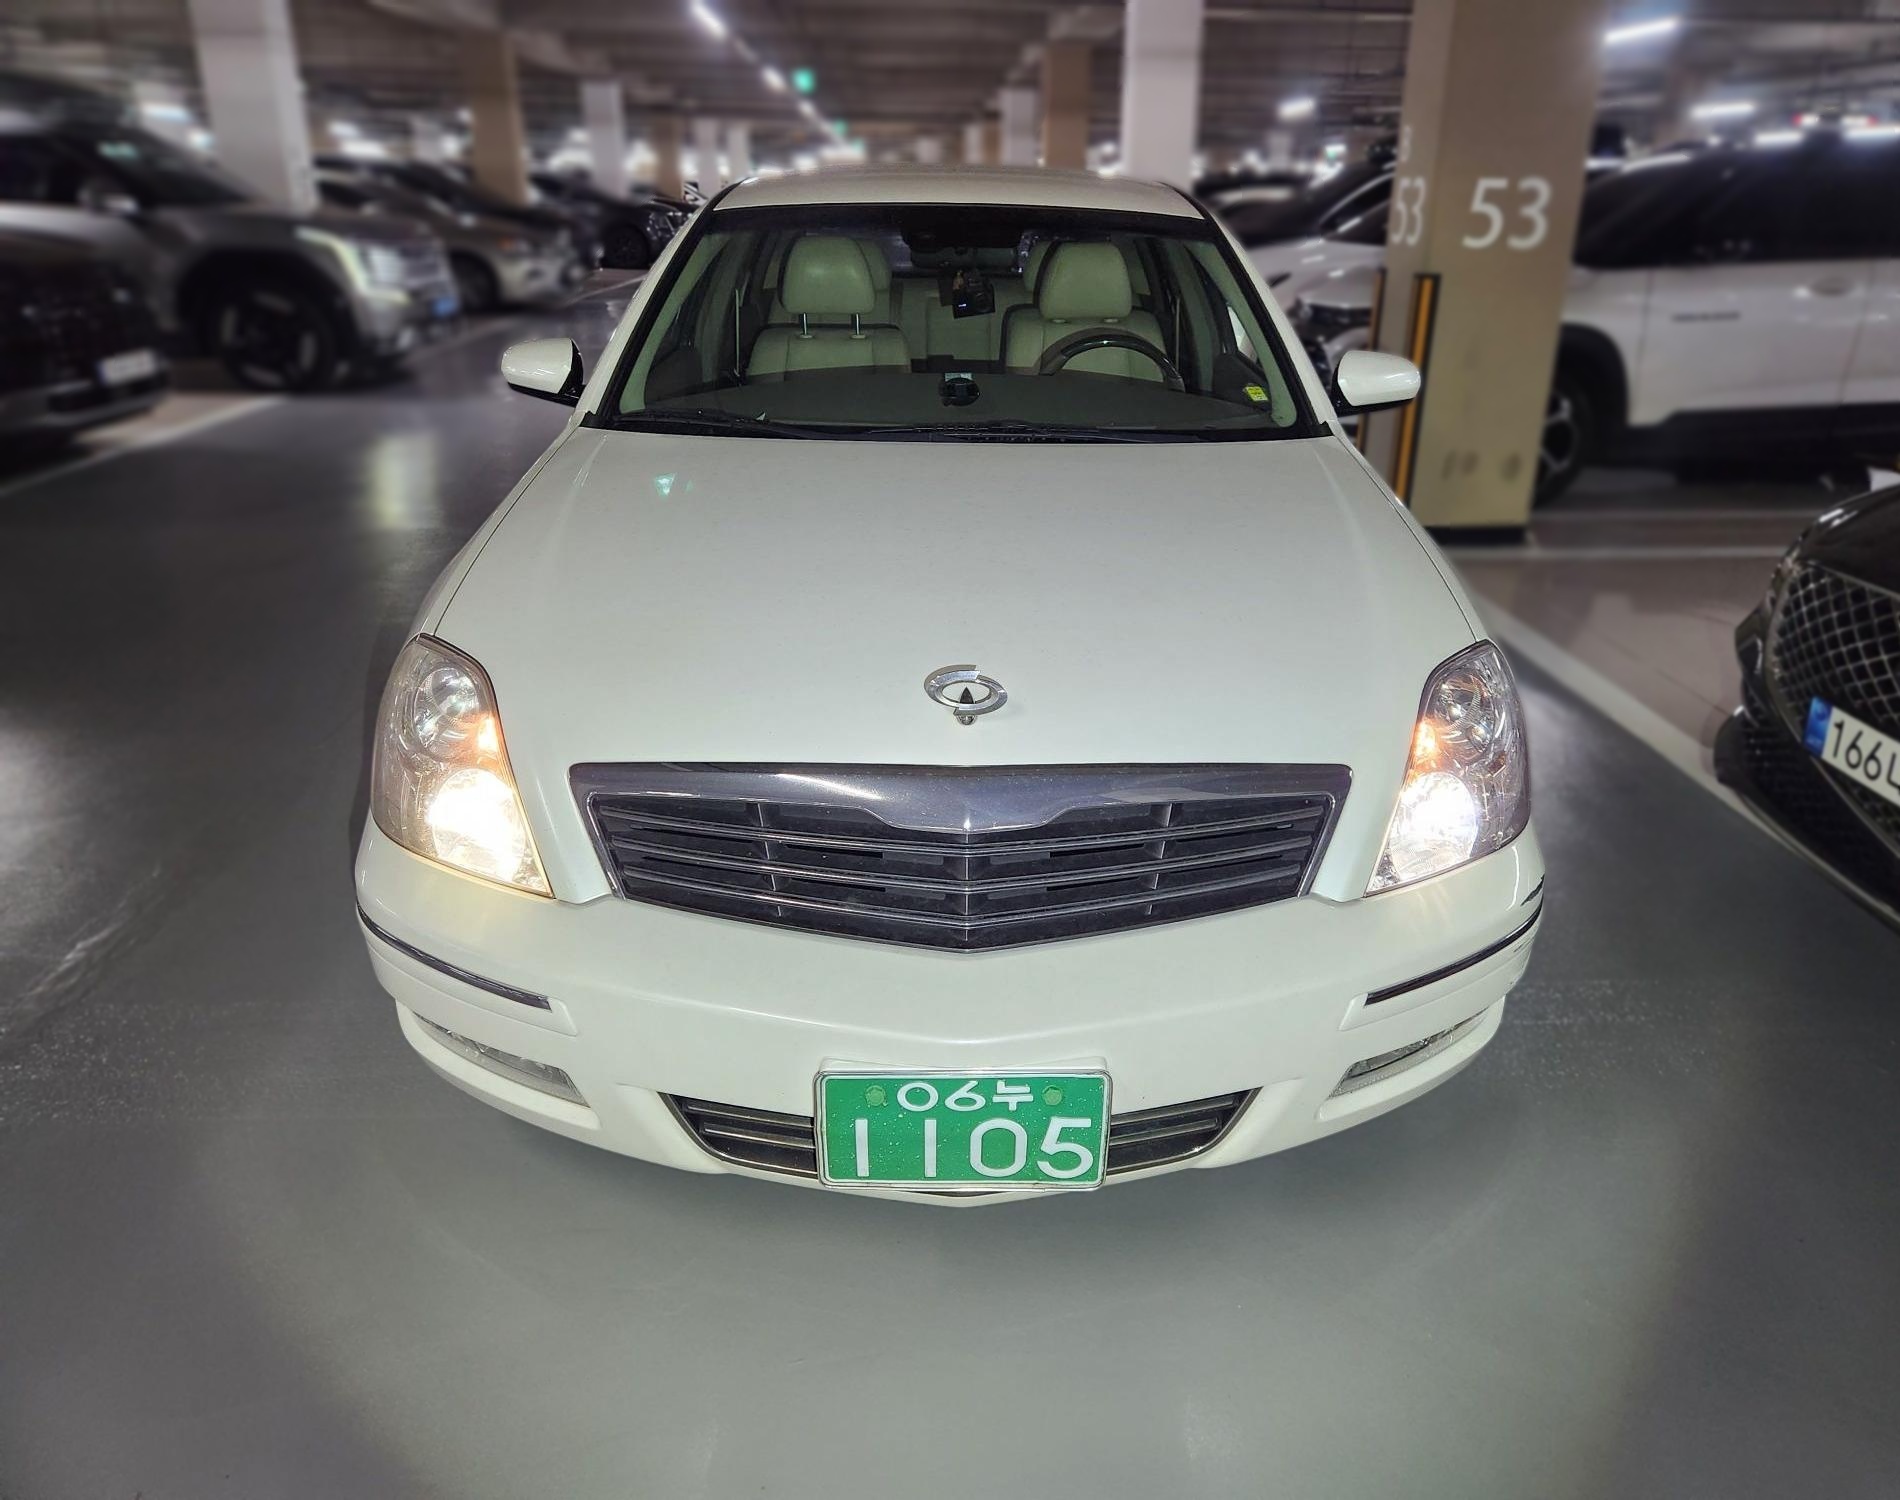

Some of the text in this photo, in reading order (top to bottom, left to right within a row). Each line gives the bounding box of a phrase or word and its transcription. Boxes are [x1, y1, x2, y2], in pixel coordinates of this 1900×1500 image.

[1391, 176, 1426, 246] 53
[1462, 176, 1554, 249] 53
[896, 1080, 1034, 1112] 06누
[854, 1116, 1094, 1179] 1105
